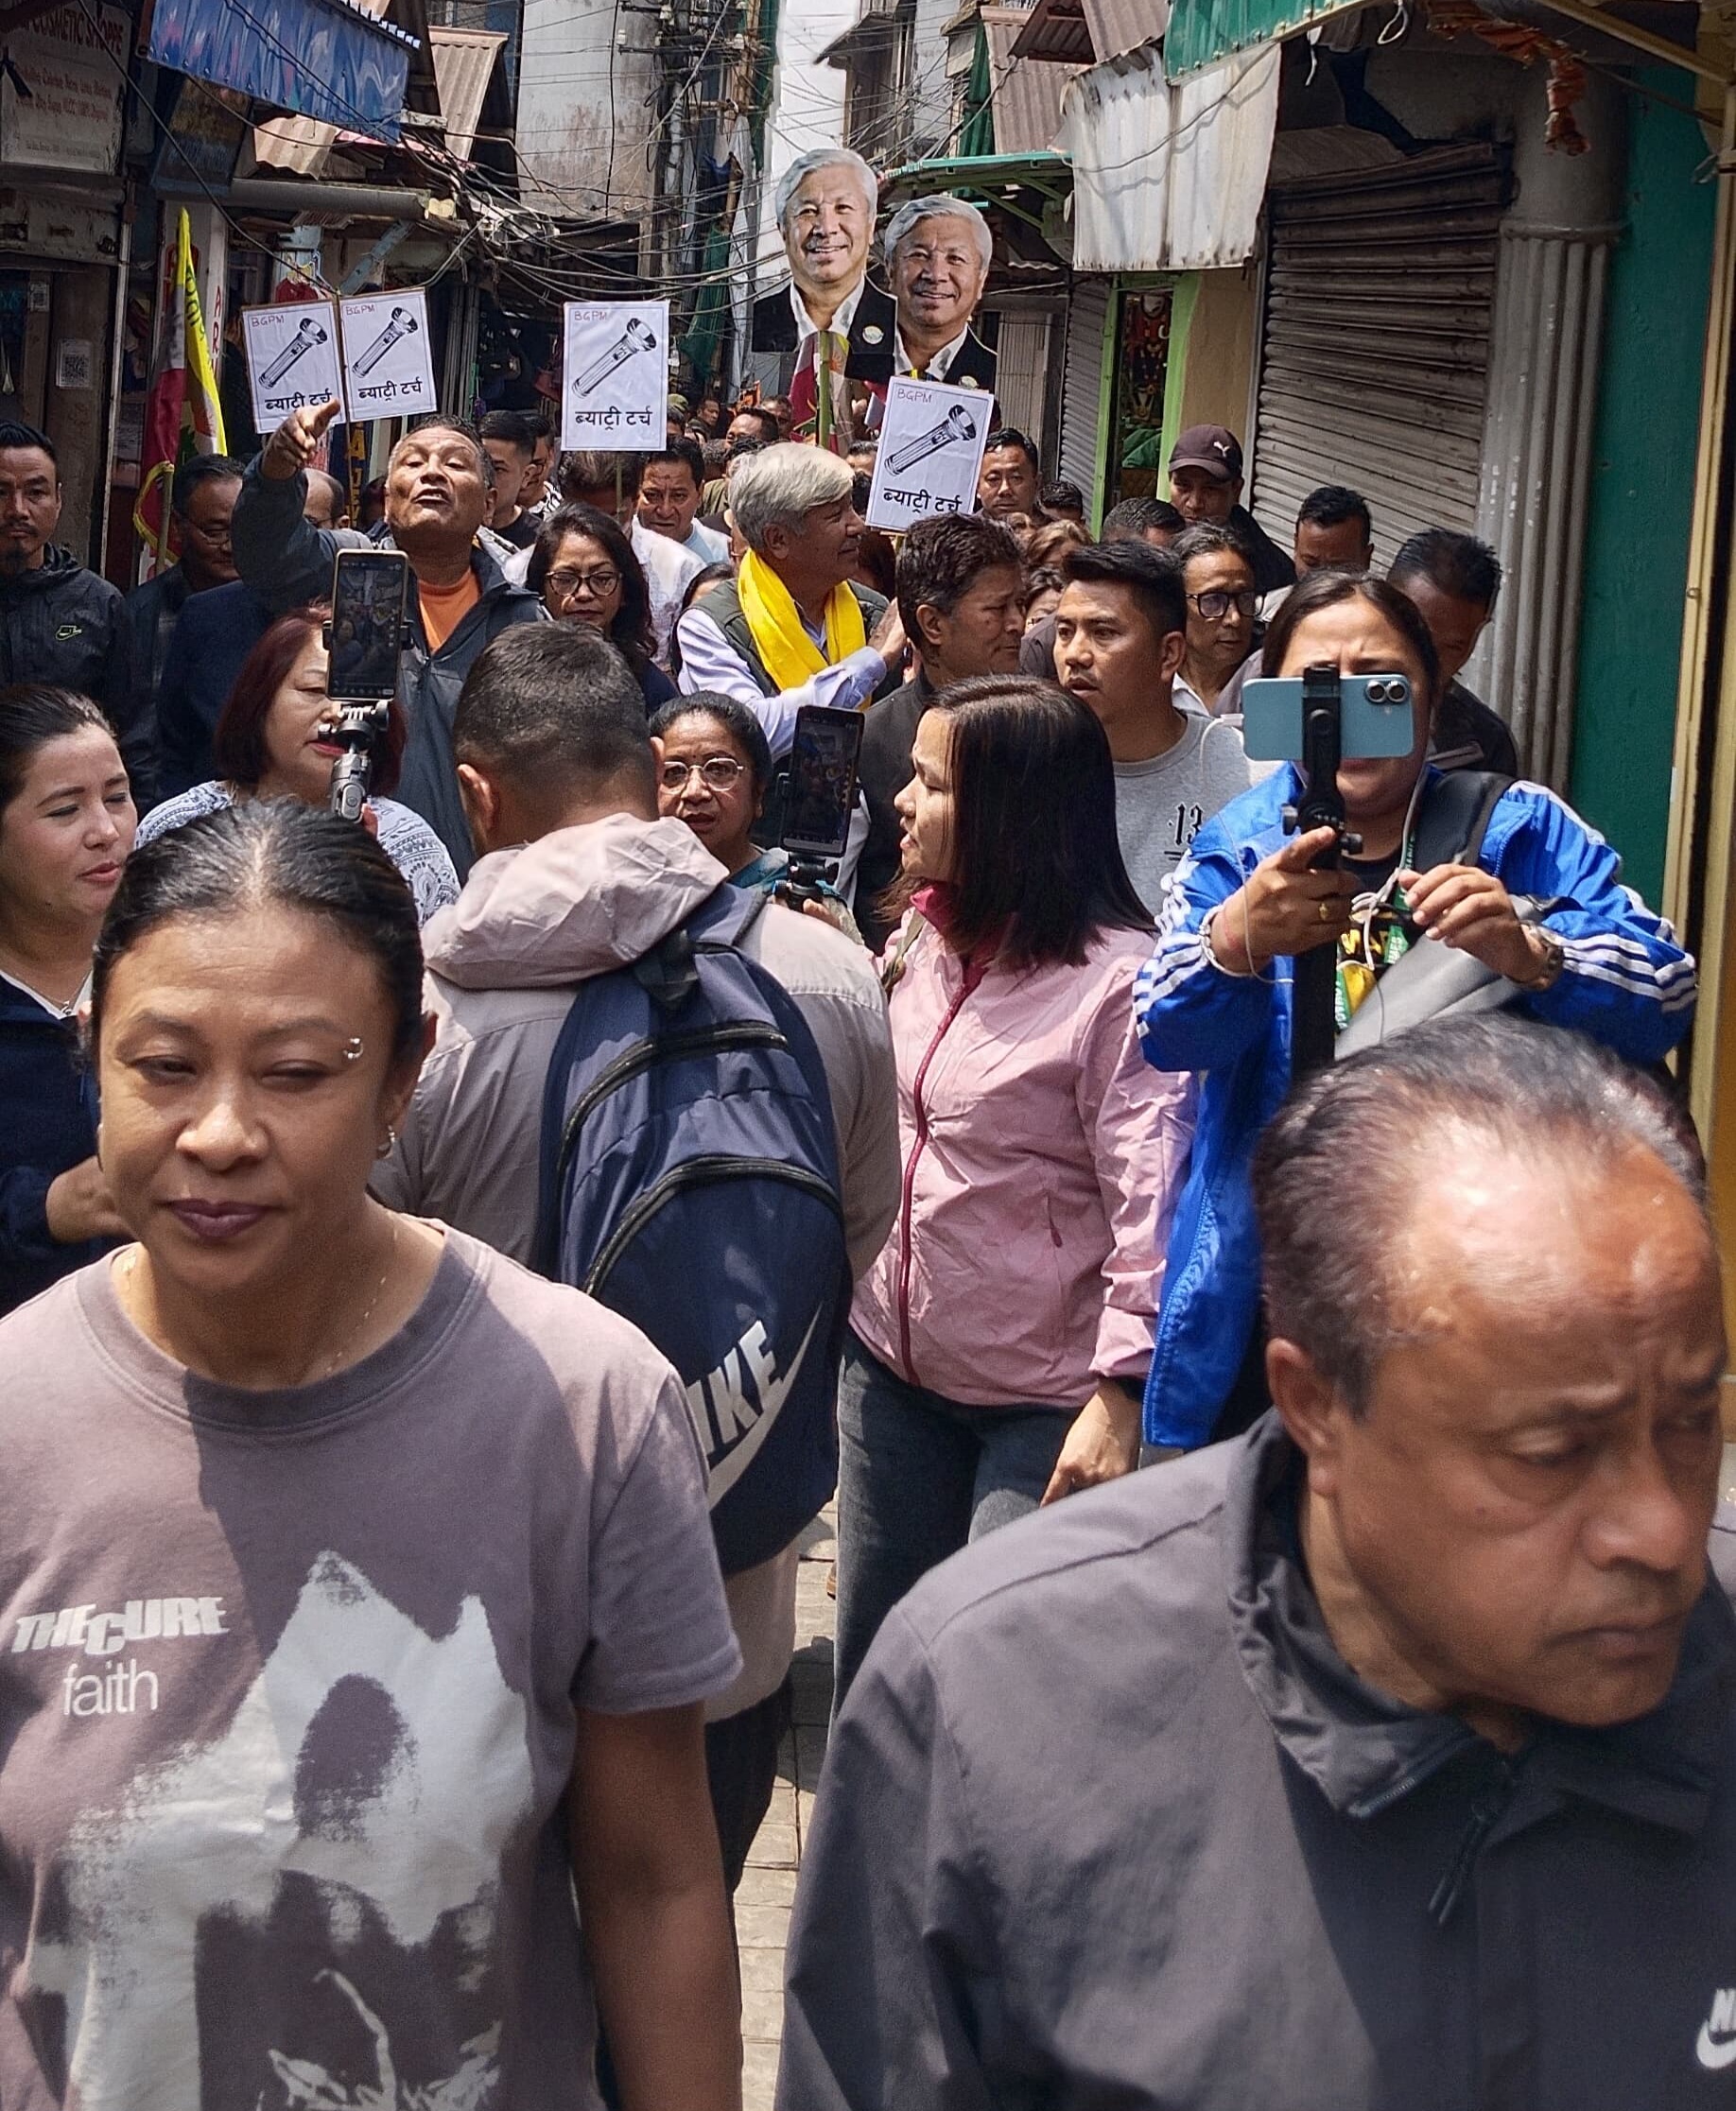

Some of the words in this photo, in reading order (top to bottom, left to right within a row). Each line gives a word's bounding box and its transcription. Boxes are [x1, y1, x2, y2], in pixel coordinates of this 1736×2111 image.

[251, 314, 285, 327] BGPM
[345, 303, 375, 316] BGPM
[574, 310, 608, 321] BGPM
[357, 380, 398, 402] ब्याट्री
[400, 376, 423, 394] टर्च
[896, 388, 932, 404] BGPM
[574, 406, 621, 431] ब्याट्री
[625, 406, 652, 426] टर्च
[882, 487, 932, 513] ब्याट्री
[934, 494, 963, 513] टर्च
[685, 1320, 784, 1456] IKE
[62, 1658, 159, 1716] faith
